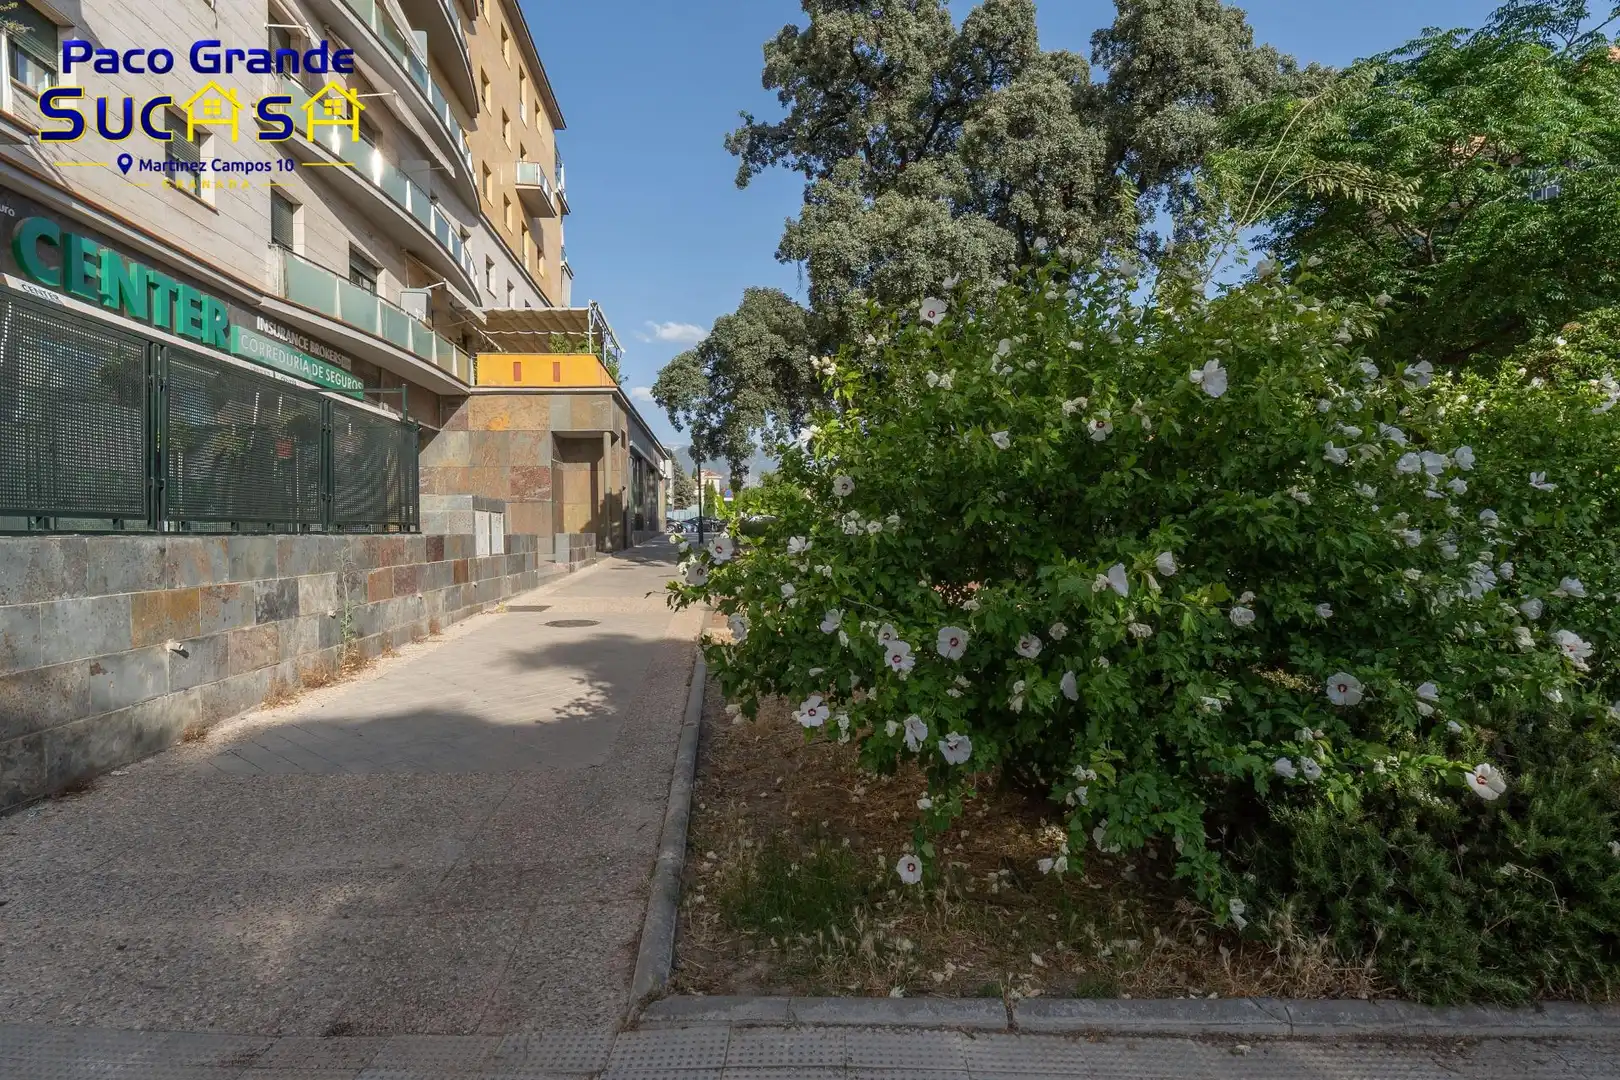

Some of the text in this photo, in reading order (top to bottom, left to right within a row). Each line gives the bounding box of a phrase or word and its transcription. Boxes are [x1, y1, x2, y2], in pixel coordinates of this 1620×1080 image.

[11, 216, 229, 350] CENTER
[256, 316, 309, 350] INSURANCE
[241, 335, 309, 373] CORREDURÍA
[311, 363, 324, 378] DE
